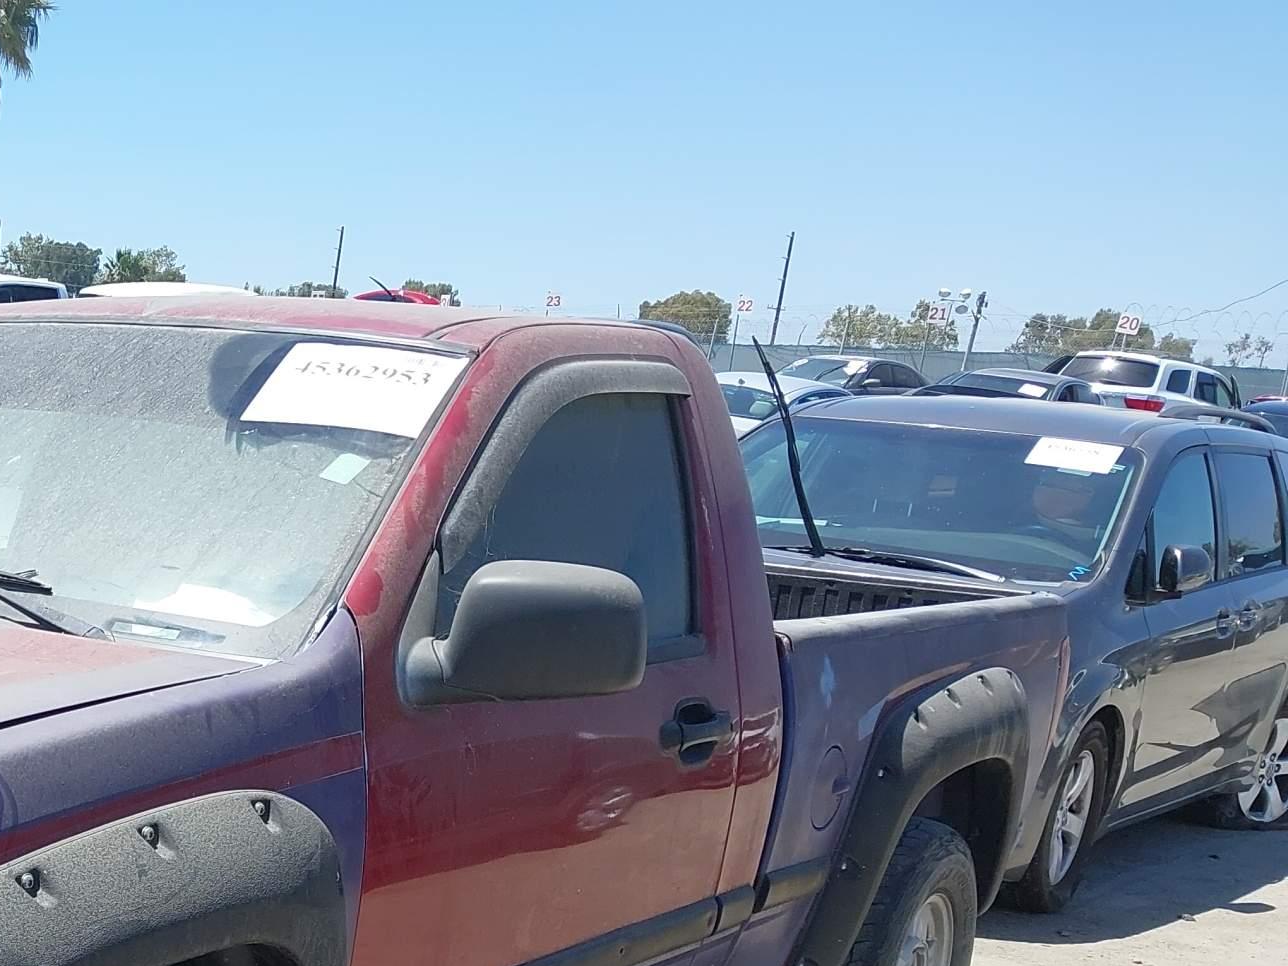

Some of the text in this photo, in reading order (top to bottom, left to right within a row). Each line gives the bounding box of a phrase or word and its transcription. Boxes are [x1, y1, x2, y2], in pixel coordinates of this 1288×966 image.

[546, 295, 561, 307] 23
[737, 300, 753, 312] 22
[929, 307, 946, 320] 21
[1118, 315, 1140, 331] 20
[295, 359, 432, 385] 45362953
